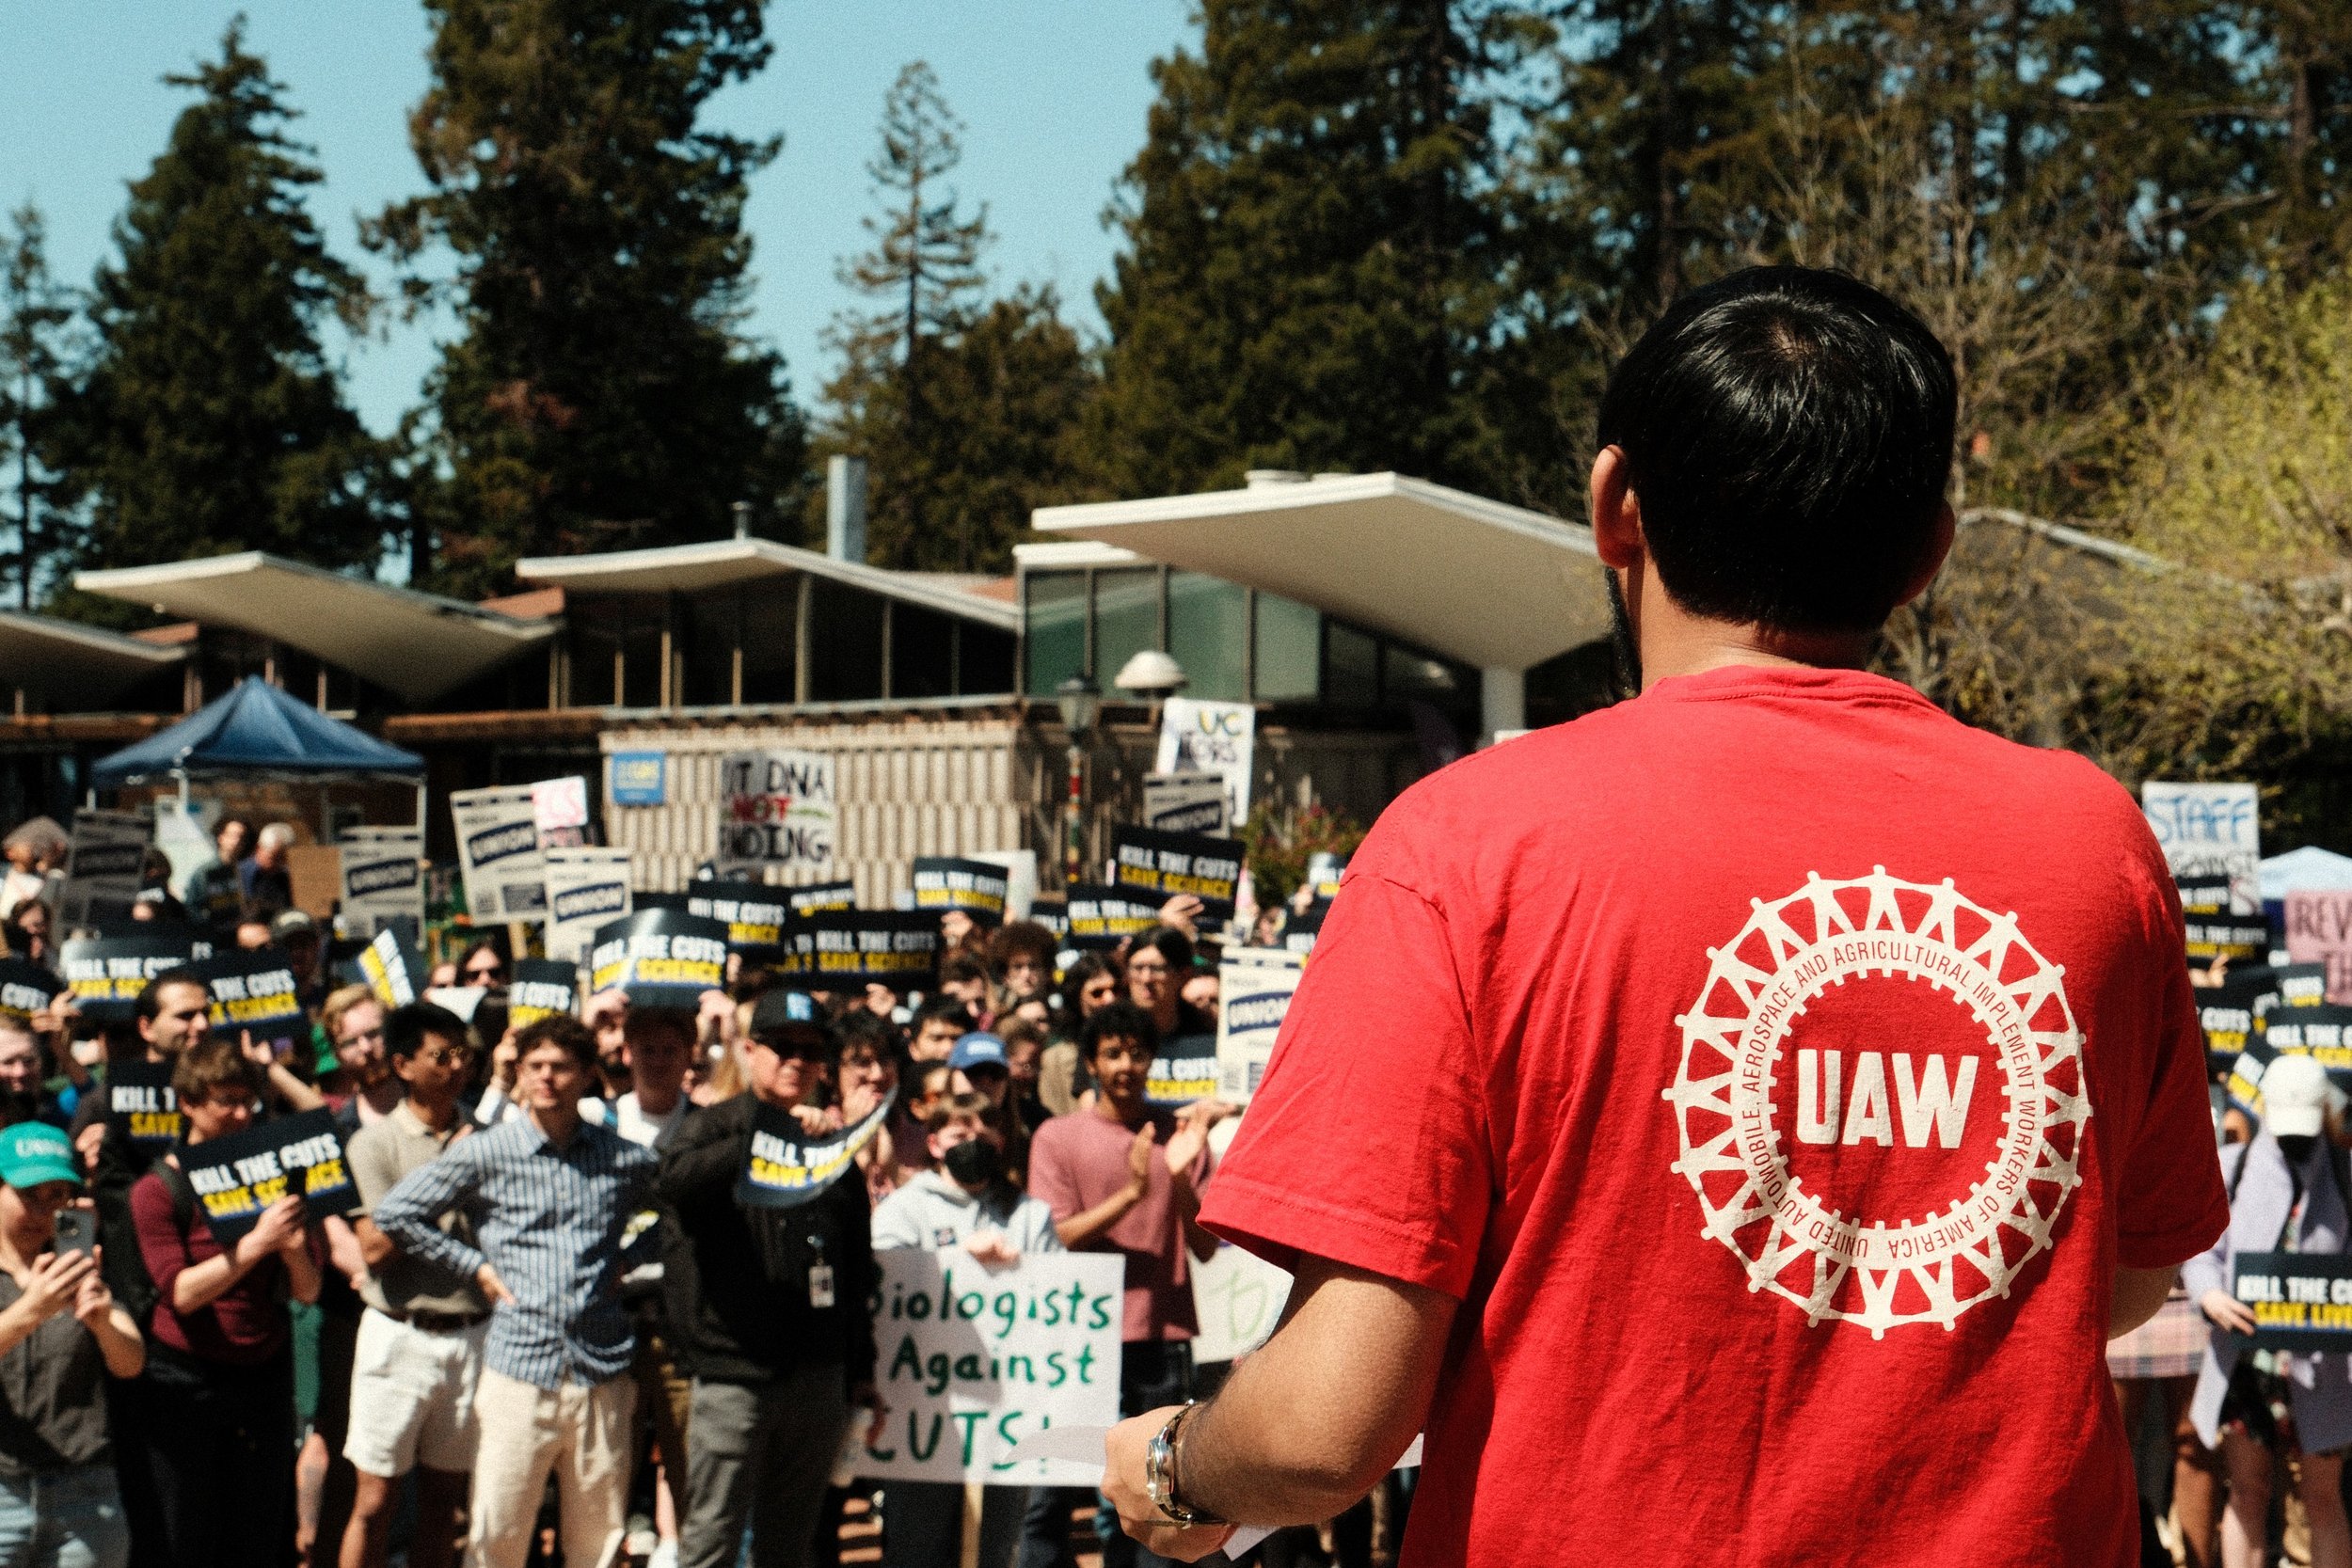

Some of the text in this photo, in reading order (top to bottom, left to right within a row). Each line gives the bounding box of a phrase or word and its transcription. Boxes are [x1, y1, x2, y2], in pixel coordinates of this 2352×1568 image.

[767, 760, 832, 800] DNA
[732, 795, 792, 823] NOT
[2144, 794, 2250, 845] STAFF
[1119, 844, 1239, 881] KILL THE CUTS
[739, 902, 786, 927] CUTS
[672, 935, 726, 965] CUTS
[816, 930, 937, 953] KILL THE CUTS
[106, 957, 141, 980] THE
[636, 958, 723, 987] SCIENCE
[818, 952, 861, 974] SAVE
[210, 969, 296, 1003] THE CUTS
[524, 981, 571, 1011] CUTS
[227, 991, 300, 1023] SCIENCE
[1171, 1056, 1216, 1082] CUTS
[112, 1085, 160, 1113] KILL
[1741, 941, 2037, 1259] UNITED AUTOMOBILE, AEROSPACE AND AGRICULTURAL IMPLEMENT WORKERS OF AMERICA
[1797, 1048, 1979, 1149] UAW
[189, 1132, 342, 1196] KILL THE CUTS
[751, 1130, 800, 1167] KILL
[749, 1155, 807, 1188] SAVE
[202, 1185, 257, 1219] SAVE
[2237, 1275, 2285, 1303] KILL
[2286, 1275, 2329, 1305] THE
[2253, 1300, 2307, 1327] SAVE
[889, 1334, 1096, 1397] Against
